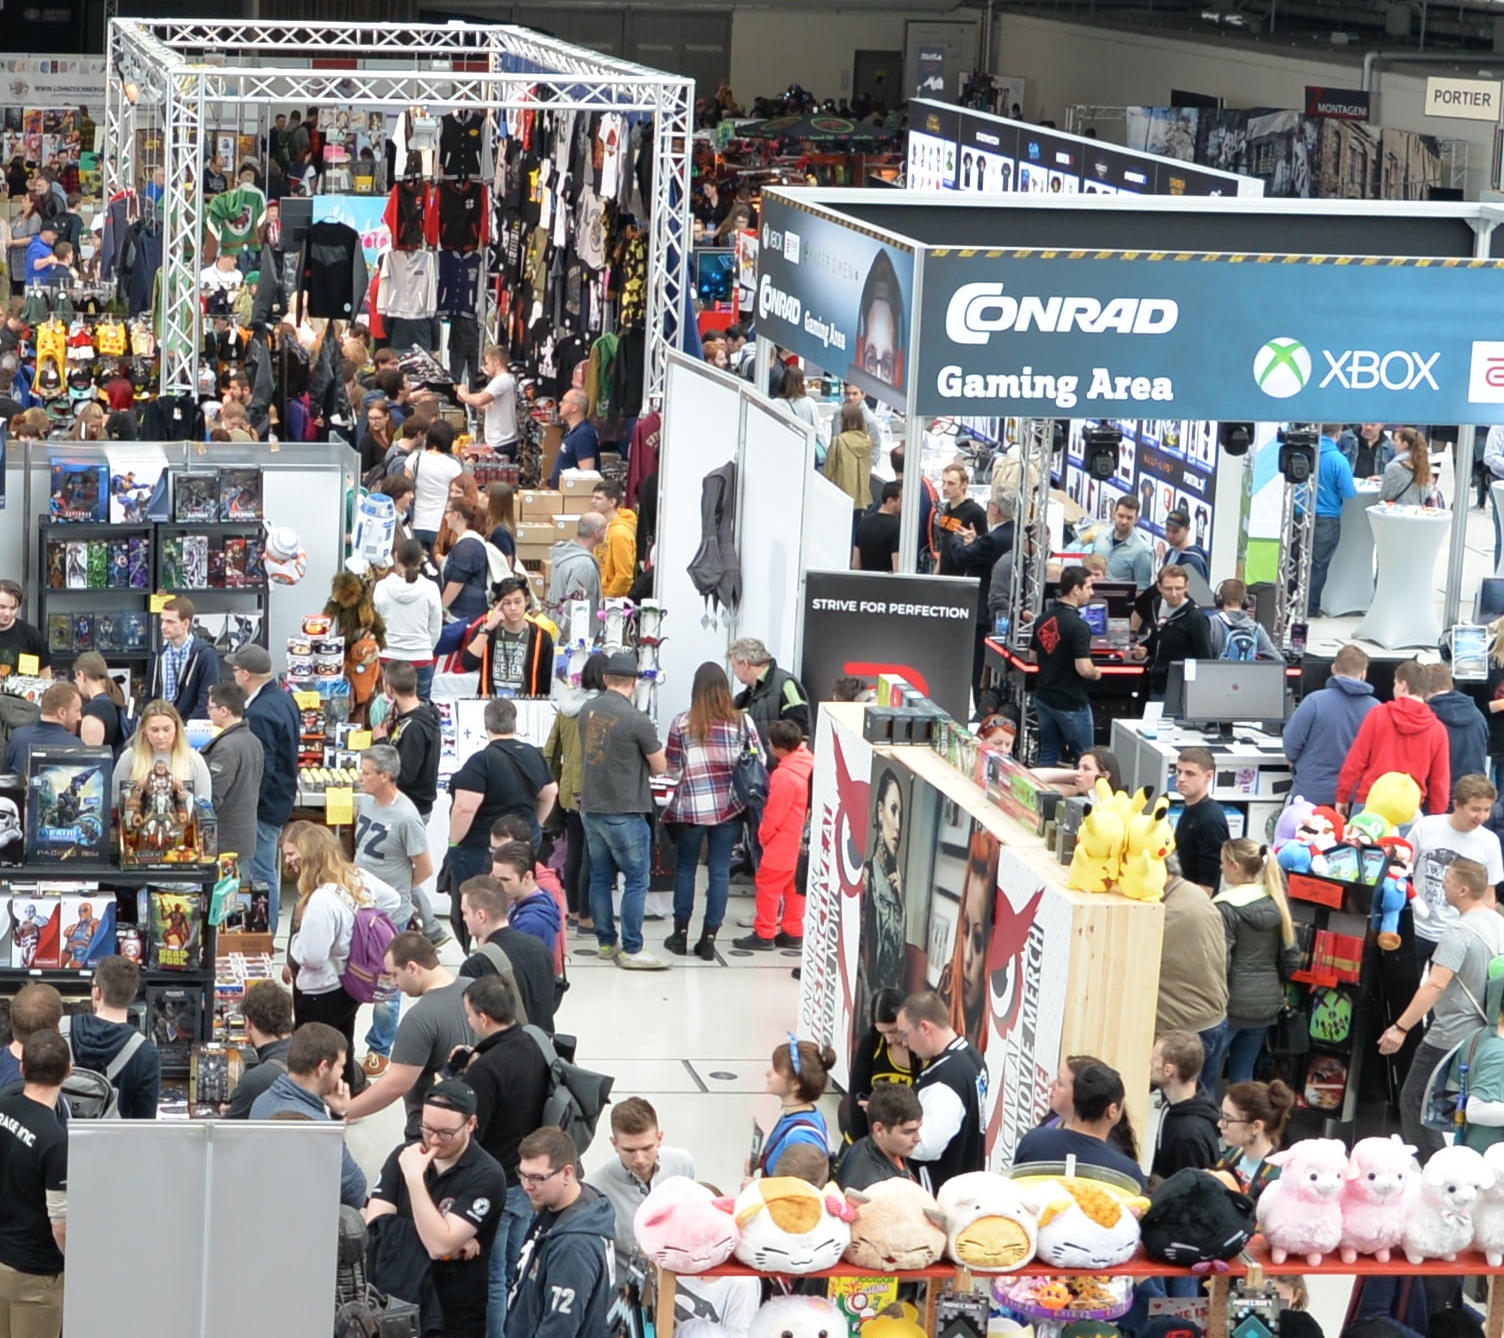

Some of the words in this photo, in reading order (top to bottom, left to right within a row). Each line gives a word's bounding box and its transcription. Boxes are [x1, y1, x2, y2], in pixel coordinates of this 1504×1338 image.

[1433, 88, 1492, 108] PORTIER
[759, 274, 801, 326] CONRAD
[945, 281, 1179, 346] CONRAD
[804, 310, 829, 348] Gaming
[829, 322, 847, 351] Area
[937, 364, 1077, 408] Gaming
[1086, 366, 1175, 402] Area
[1319, 349, 1440, 391] XBOX
[811, 598, 857, 612] STRIVE
[860, 601, 886, 613] FOR
[888, 603, 969, 620] PERFECTION
[356, 813, 389, 860] 72
[158, 949, 188, 958] DEAD
[158, 957, 187, 966] POOL
[1023, 925, 1045, 1032] MERCH
[550, 1285, 576, 1314] 72
